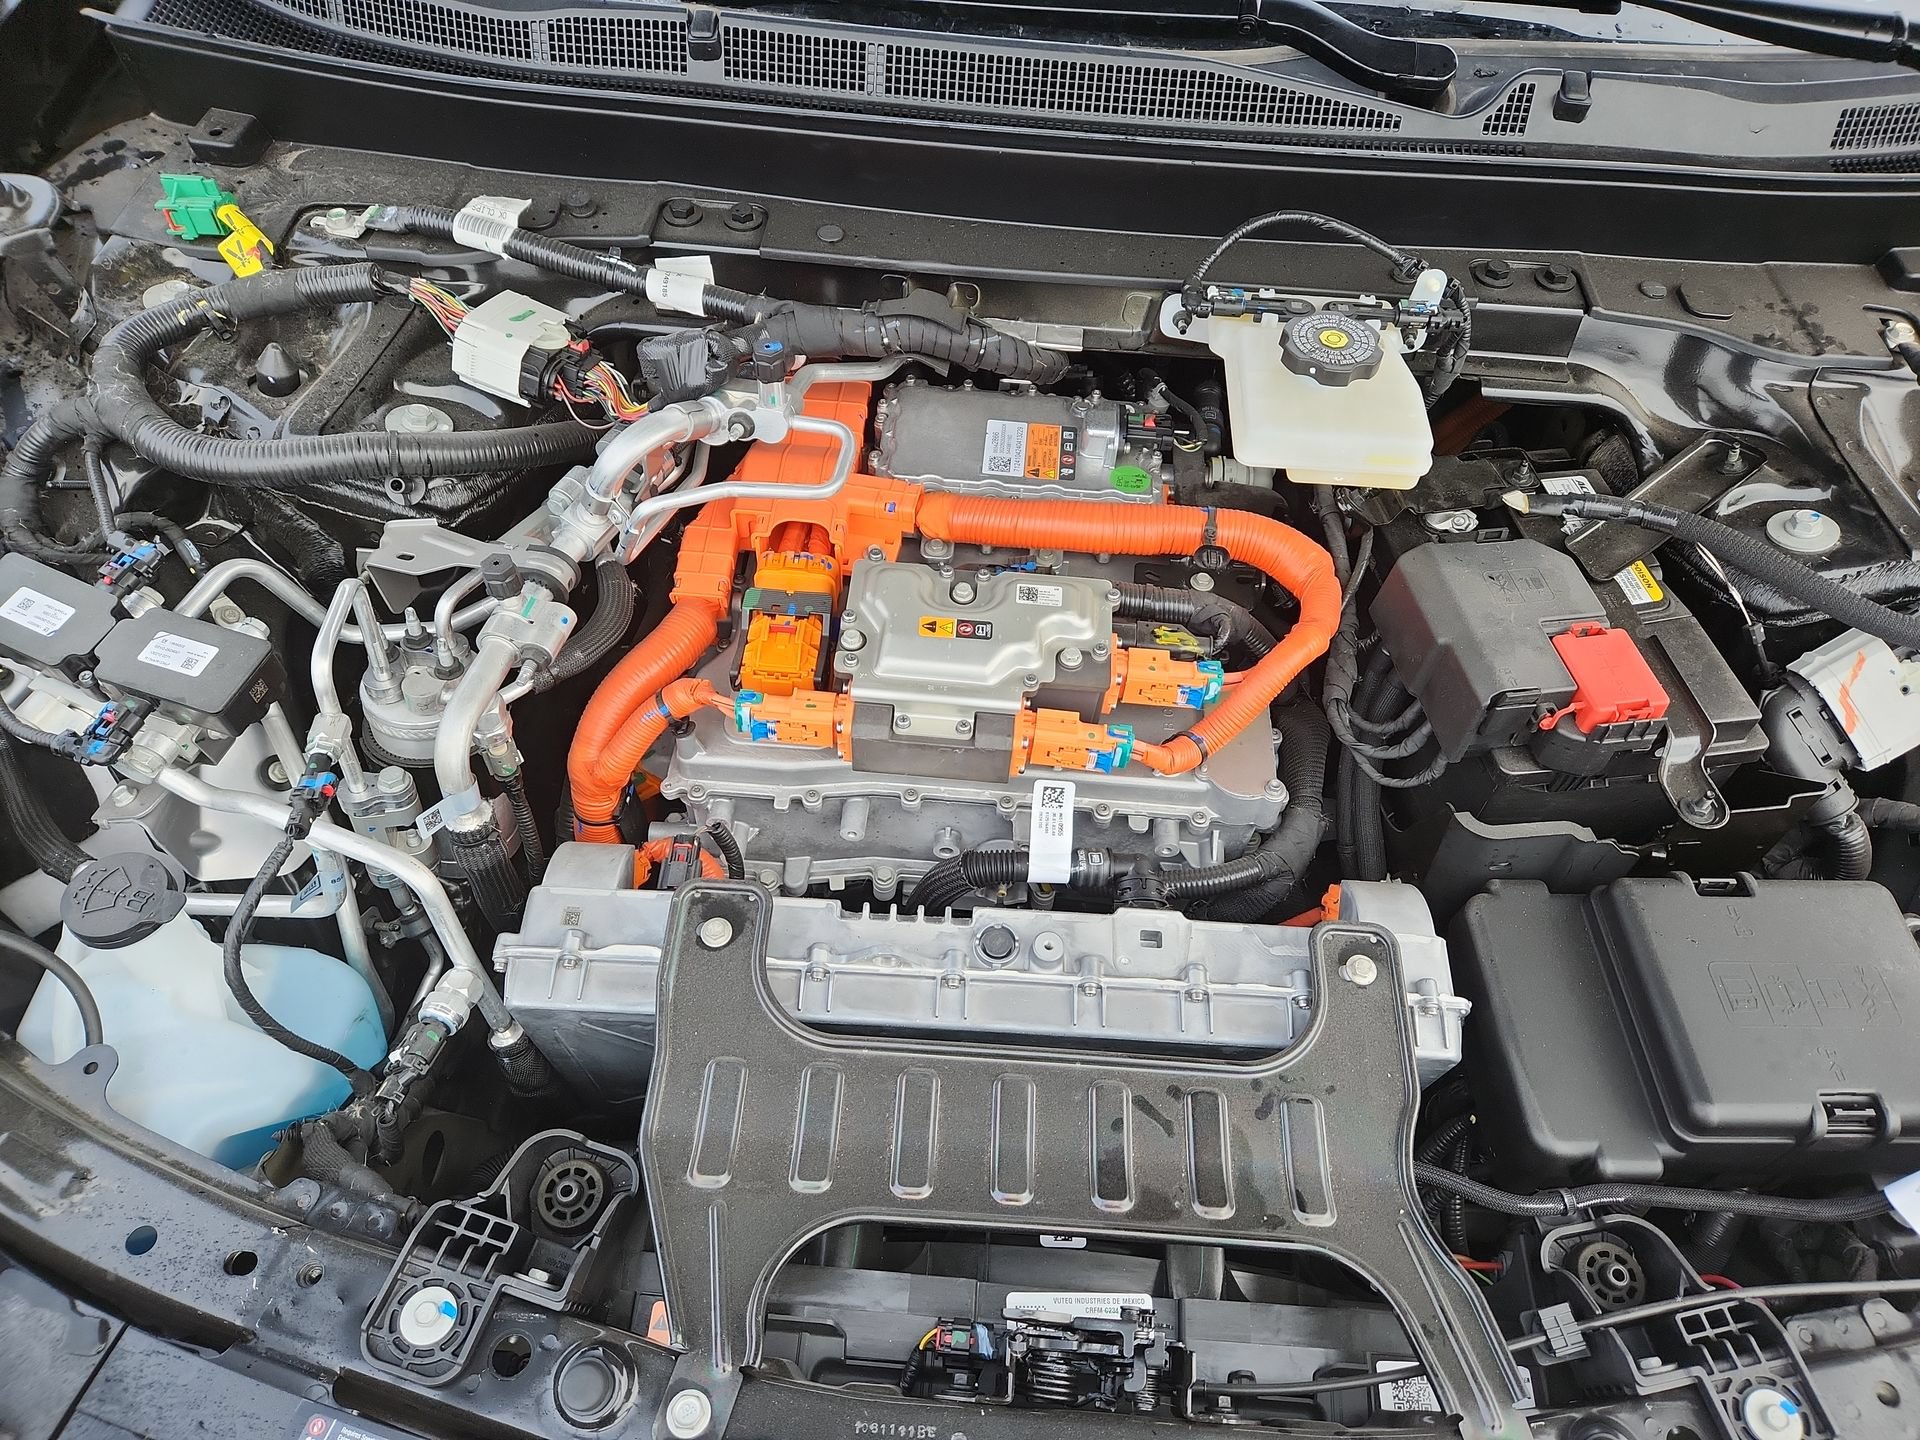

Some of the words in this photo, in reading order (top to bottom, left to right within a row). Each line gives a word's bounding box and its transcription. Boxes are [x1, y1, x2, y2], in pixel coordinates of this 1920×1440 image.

[1053, 1297, 1073, 1305] VUTEQ
[1074, 1297, 1111, 1305] INDUSTRIES
[1122, 1298, 1146, 1306] MEXICO
